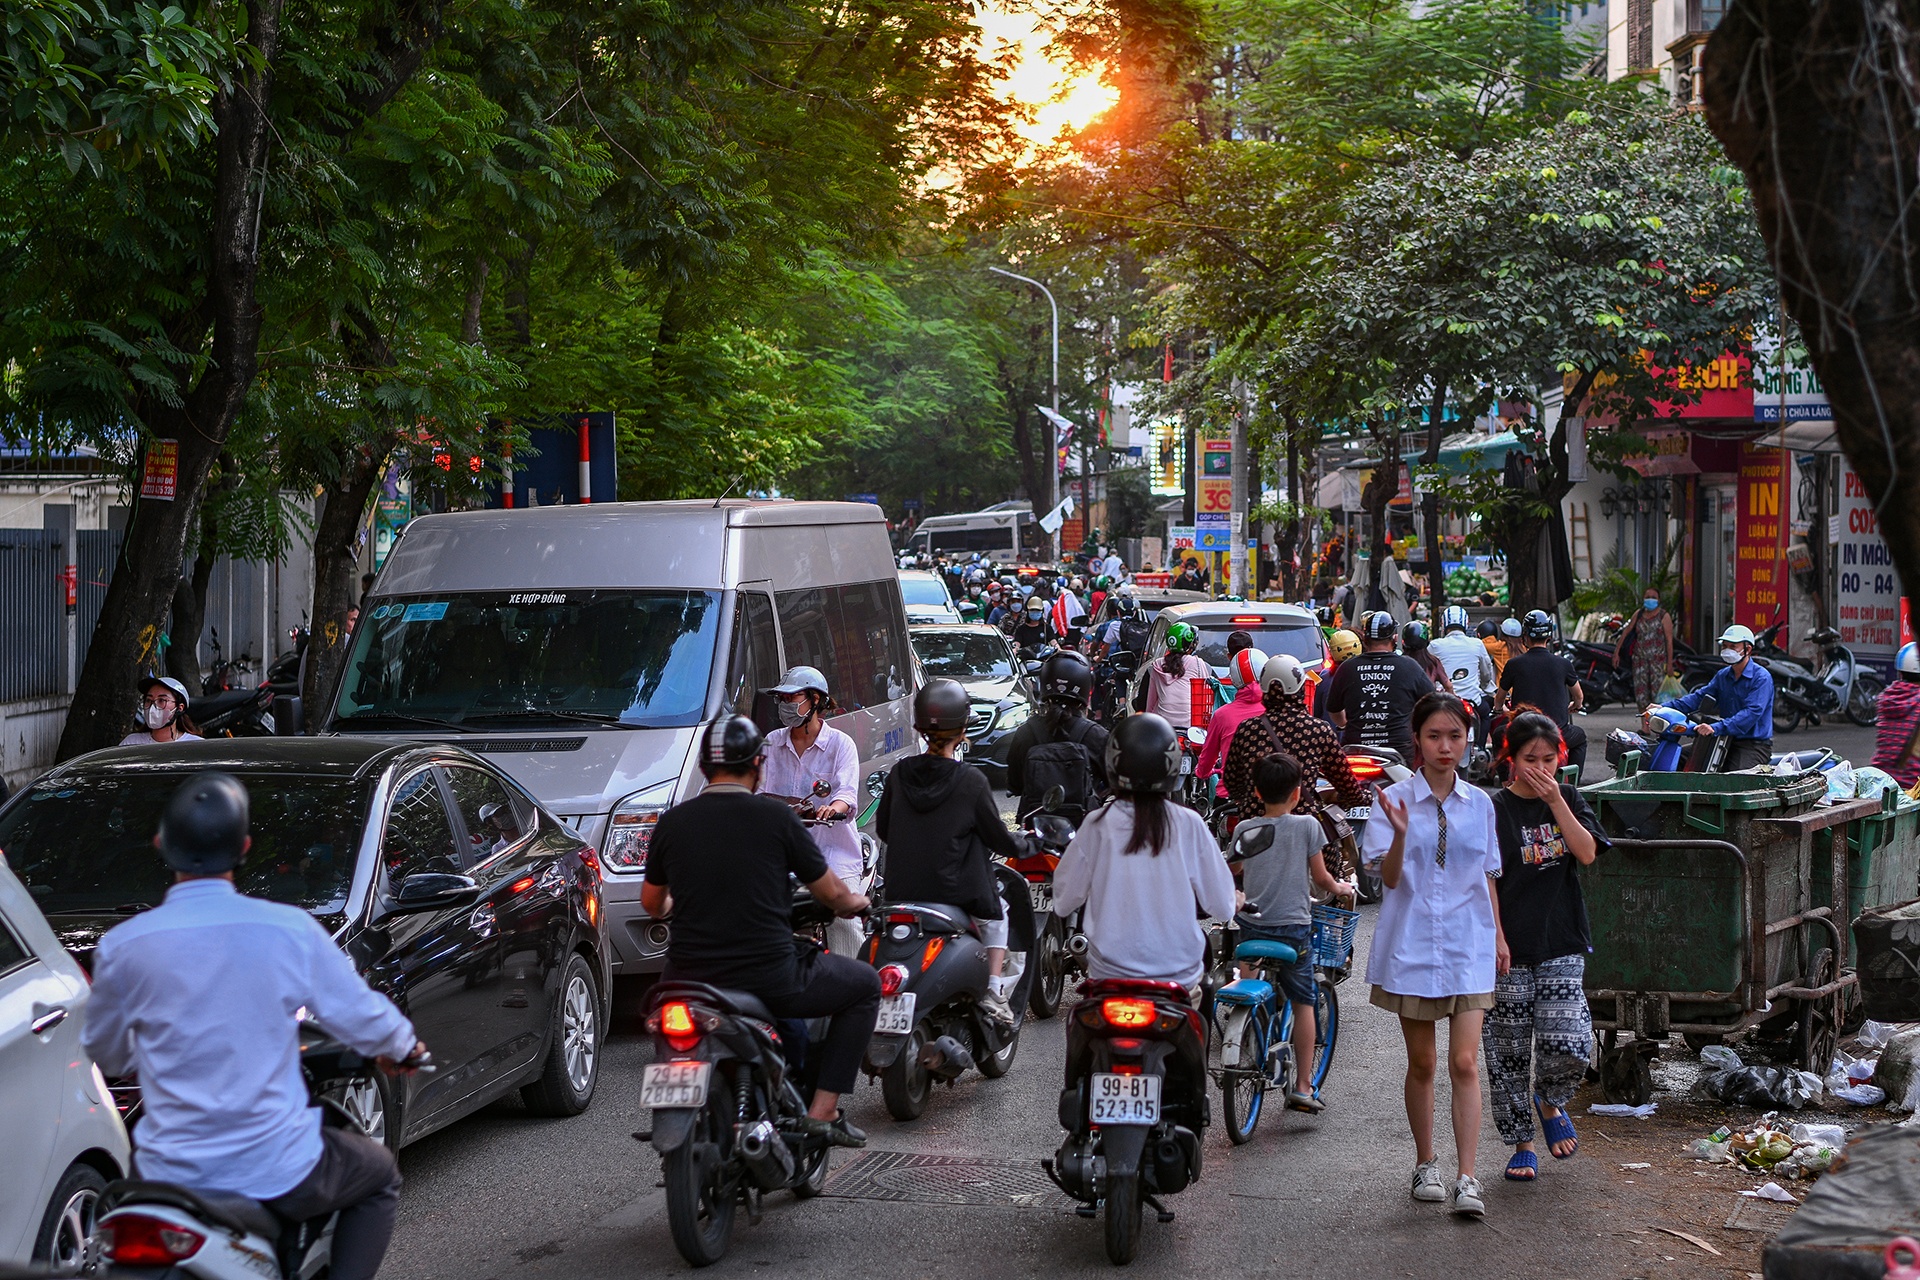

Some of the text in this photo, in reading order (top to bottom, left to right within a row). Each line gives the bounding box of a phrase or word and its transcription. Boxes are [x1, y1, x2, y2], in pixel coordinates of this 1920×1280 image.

[1750, 483, 1779, 515] IN
[1174, 537, 1194, 548] 30k
[1843, 544, 1857, 565] IN
[1875, 574, 1893, 594] A4
[509, 594, 521, 604] XE
[1362, 683, 1389, 693] NOAH
[651, 1066, 698, 1085] 29-E1
[643, 1086, 701, 1105] 288.60
[1102, 1077, 1148, 1097] 99-B1
[1095, 1099, 1154, 1119] 523.05
